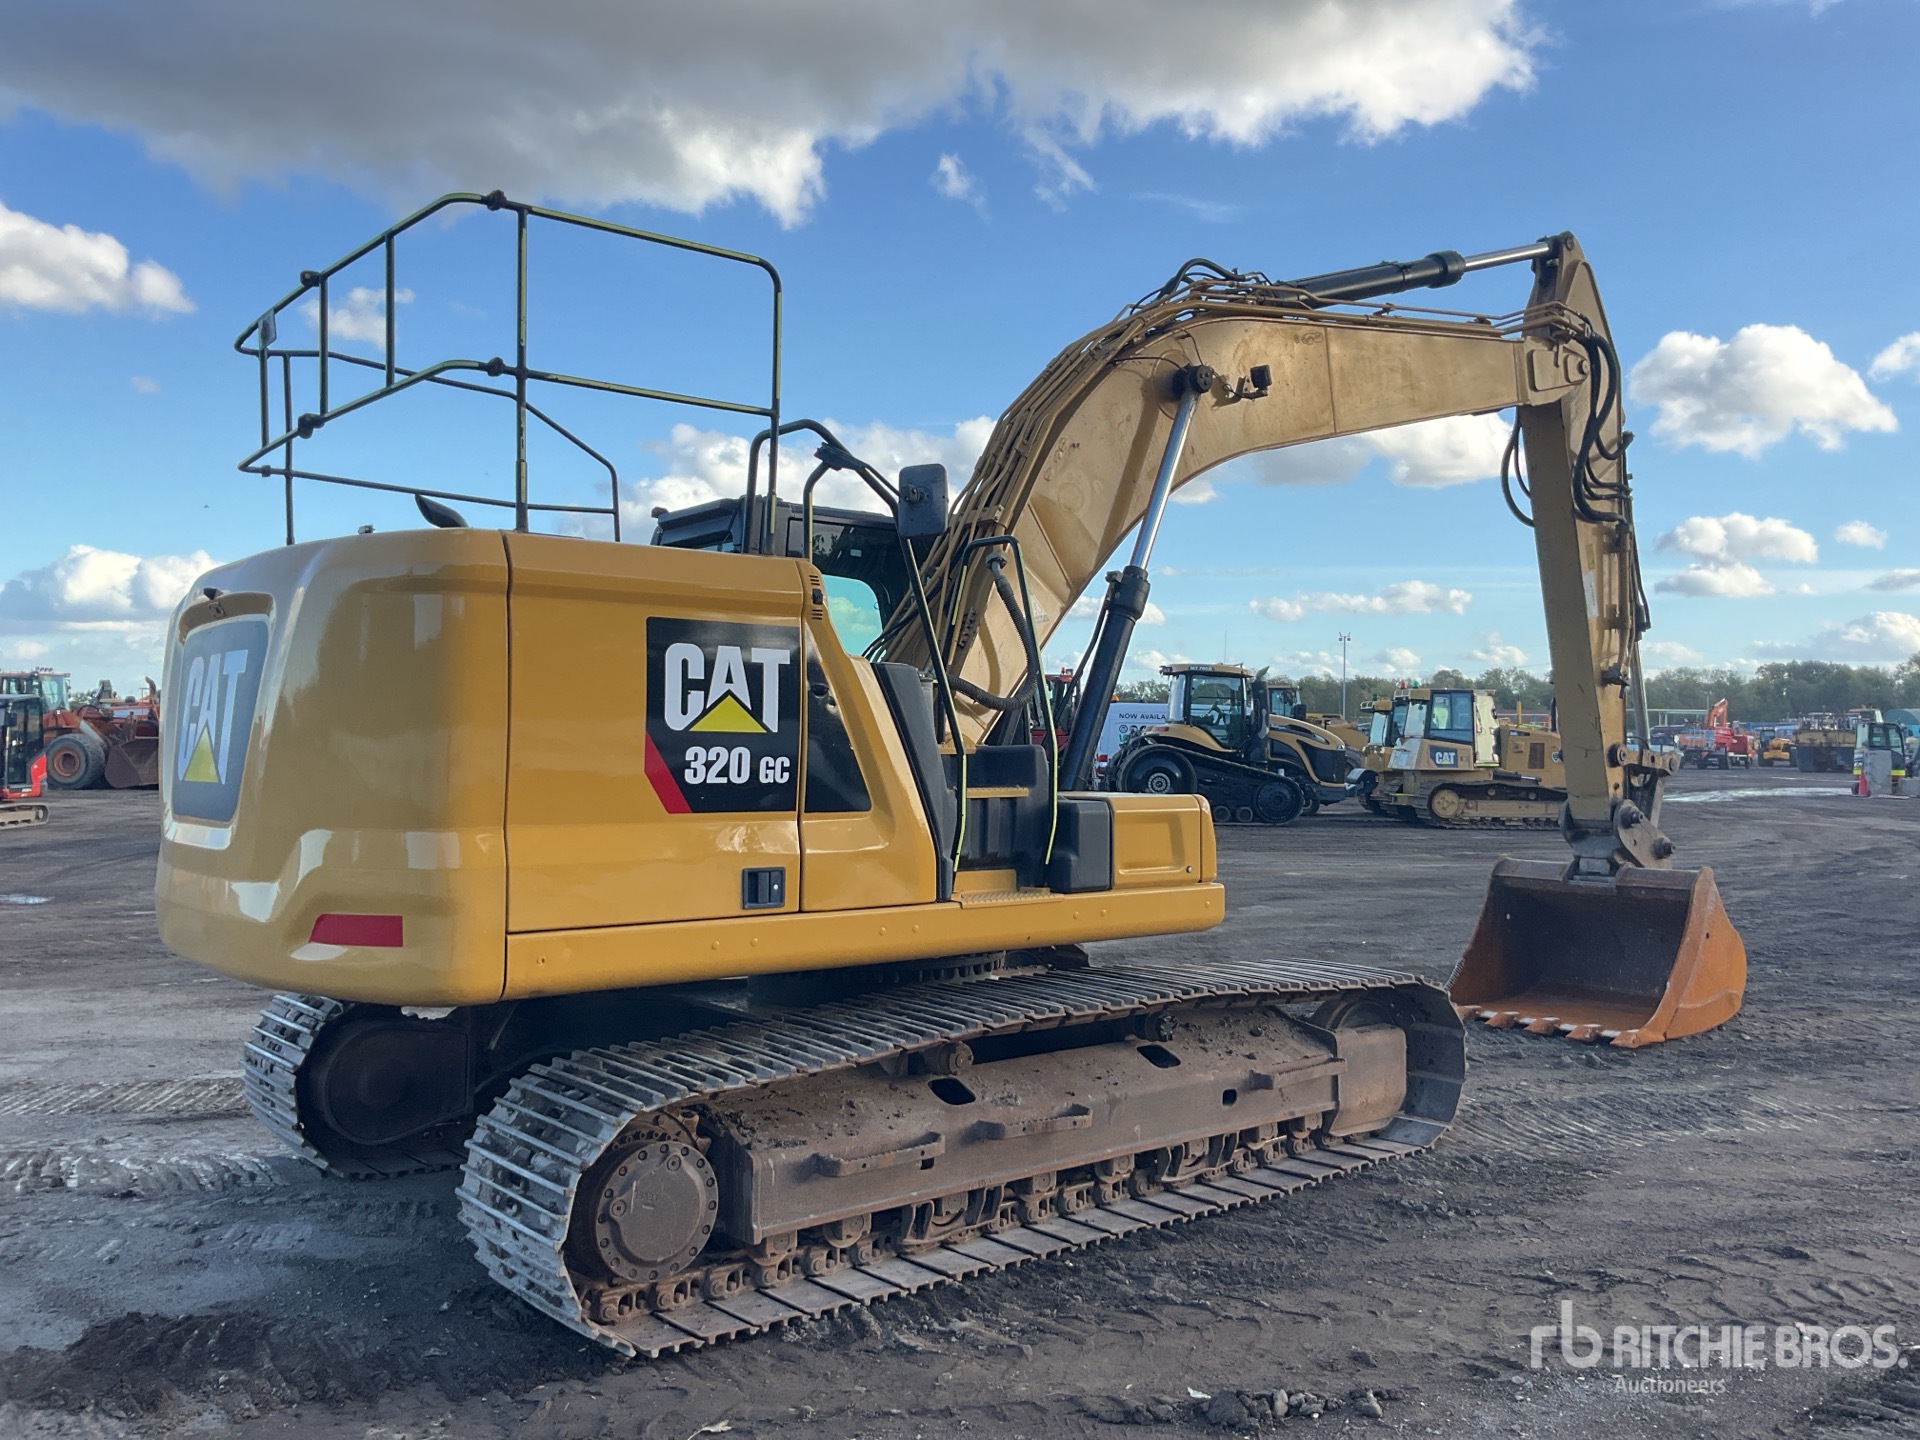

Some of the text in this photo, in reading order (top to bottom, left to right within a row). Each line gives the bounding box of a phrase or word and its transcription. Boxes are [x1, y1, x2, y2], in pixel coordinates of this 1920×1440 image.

[178, 650, 248, 784] CAT
[664, 643, 790, 733] CAT
[684, 746, 790, 785] 320 GC
[1435, 751, 1456, 765] CAT
